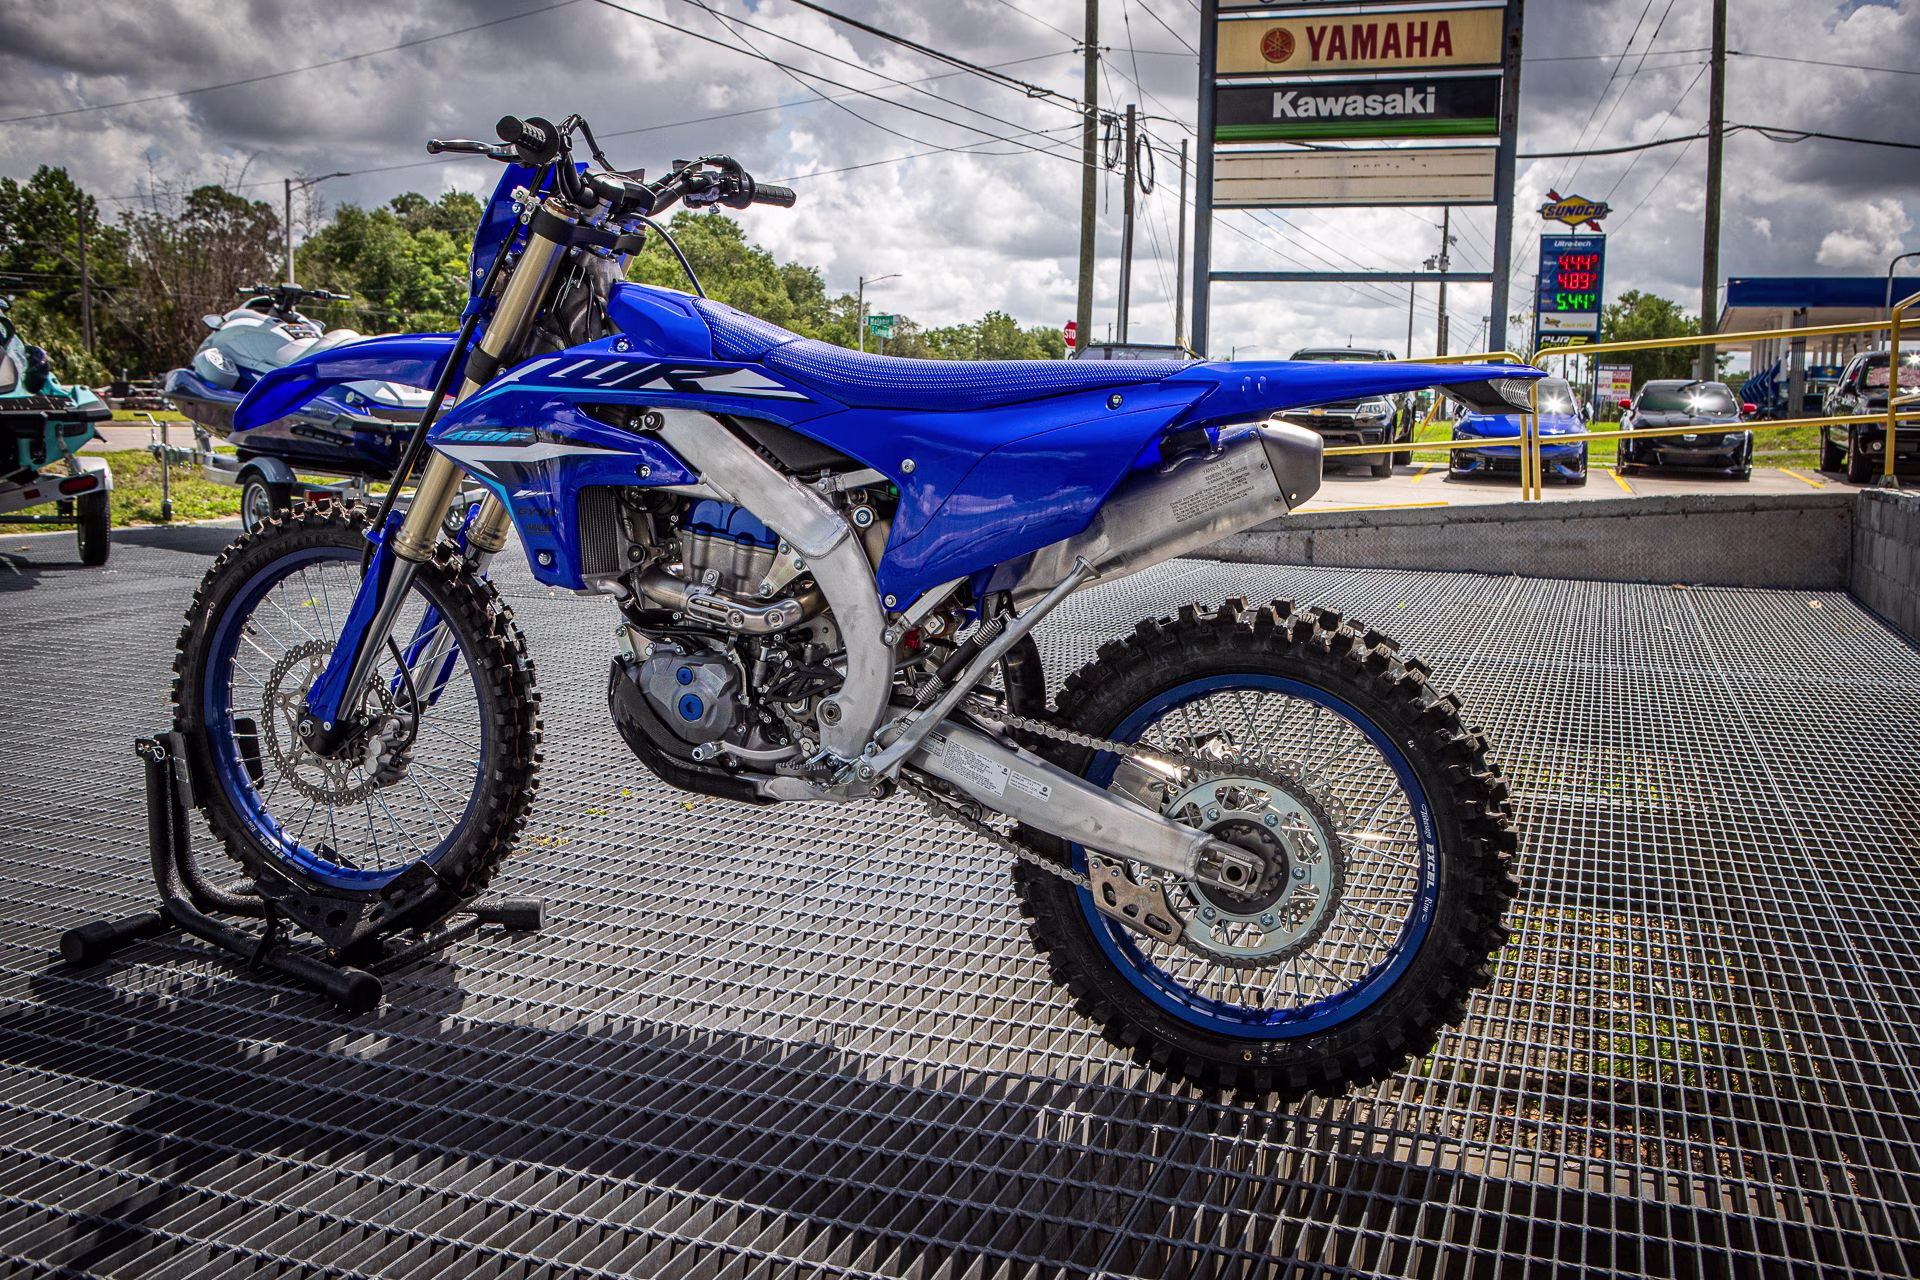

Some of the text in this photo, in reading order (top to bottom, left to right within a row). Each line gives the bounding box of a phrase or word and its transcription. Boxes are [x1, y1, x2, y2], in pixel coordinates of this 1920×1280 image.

[1305, 20, 1453, 61] YAMAHA
[1272, 87, 1436, 118] Kawasaki
[1546, 205, 1603, 217] SUNOCO
[1064, 329, 1076, 339] STO
[260, 834, 285, 859] EXCEL
[1425, 843, 1435, 889] EXCEL
